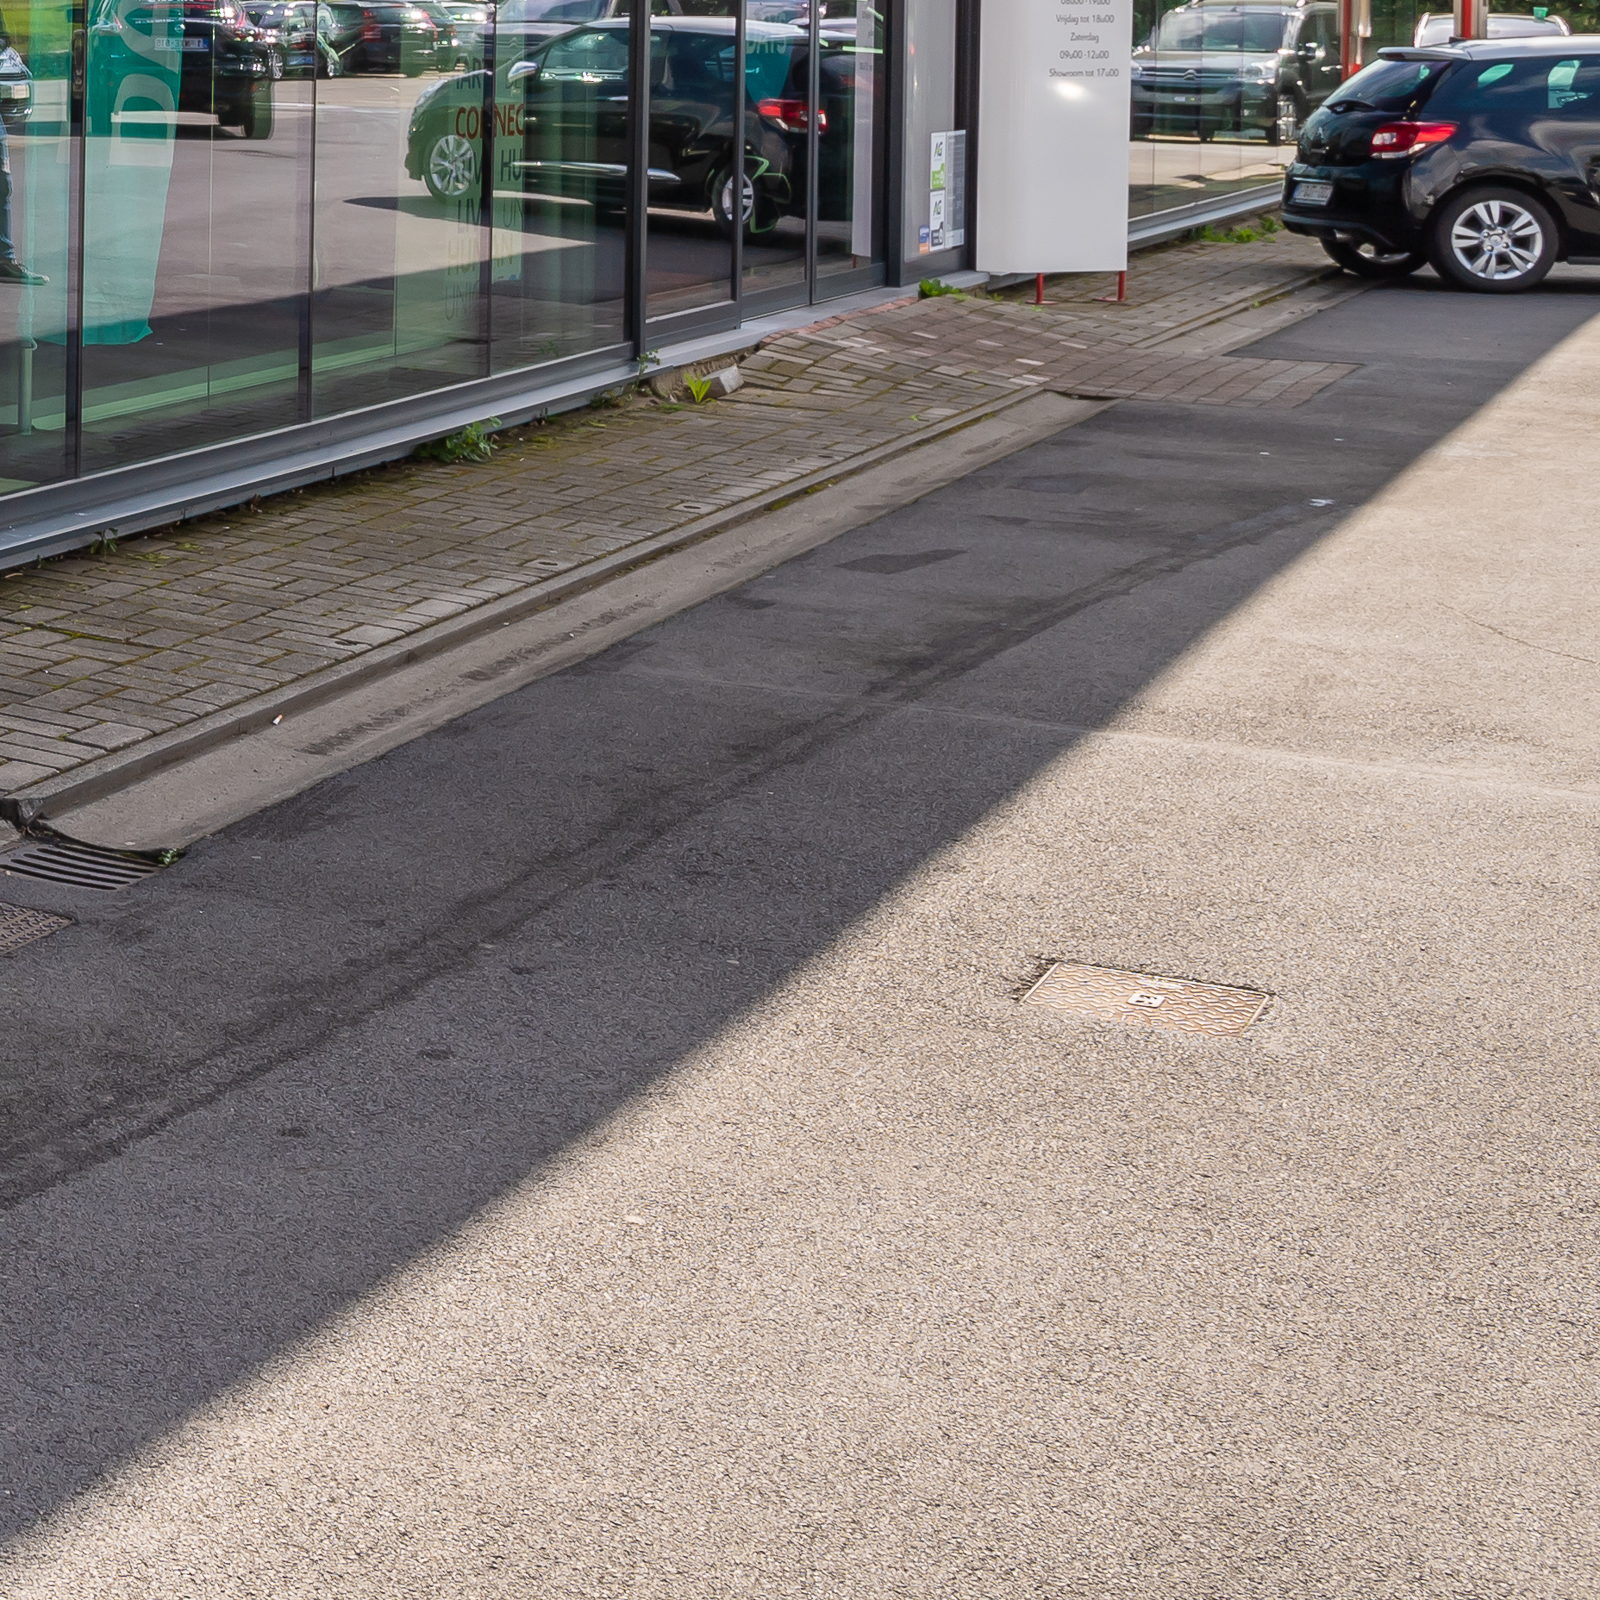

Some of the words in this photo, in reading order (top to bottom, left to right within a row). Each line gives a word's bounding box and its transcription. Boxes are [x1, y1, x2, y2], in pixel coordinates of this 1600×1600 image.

[1056, 14, 1079, 25] Vrijdag
[1070, 32, 1099, 44] Zaterdag
[1049, 68, 1084, 77] Showroom
